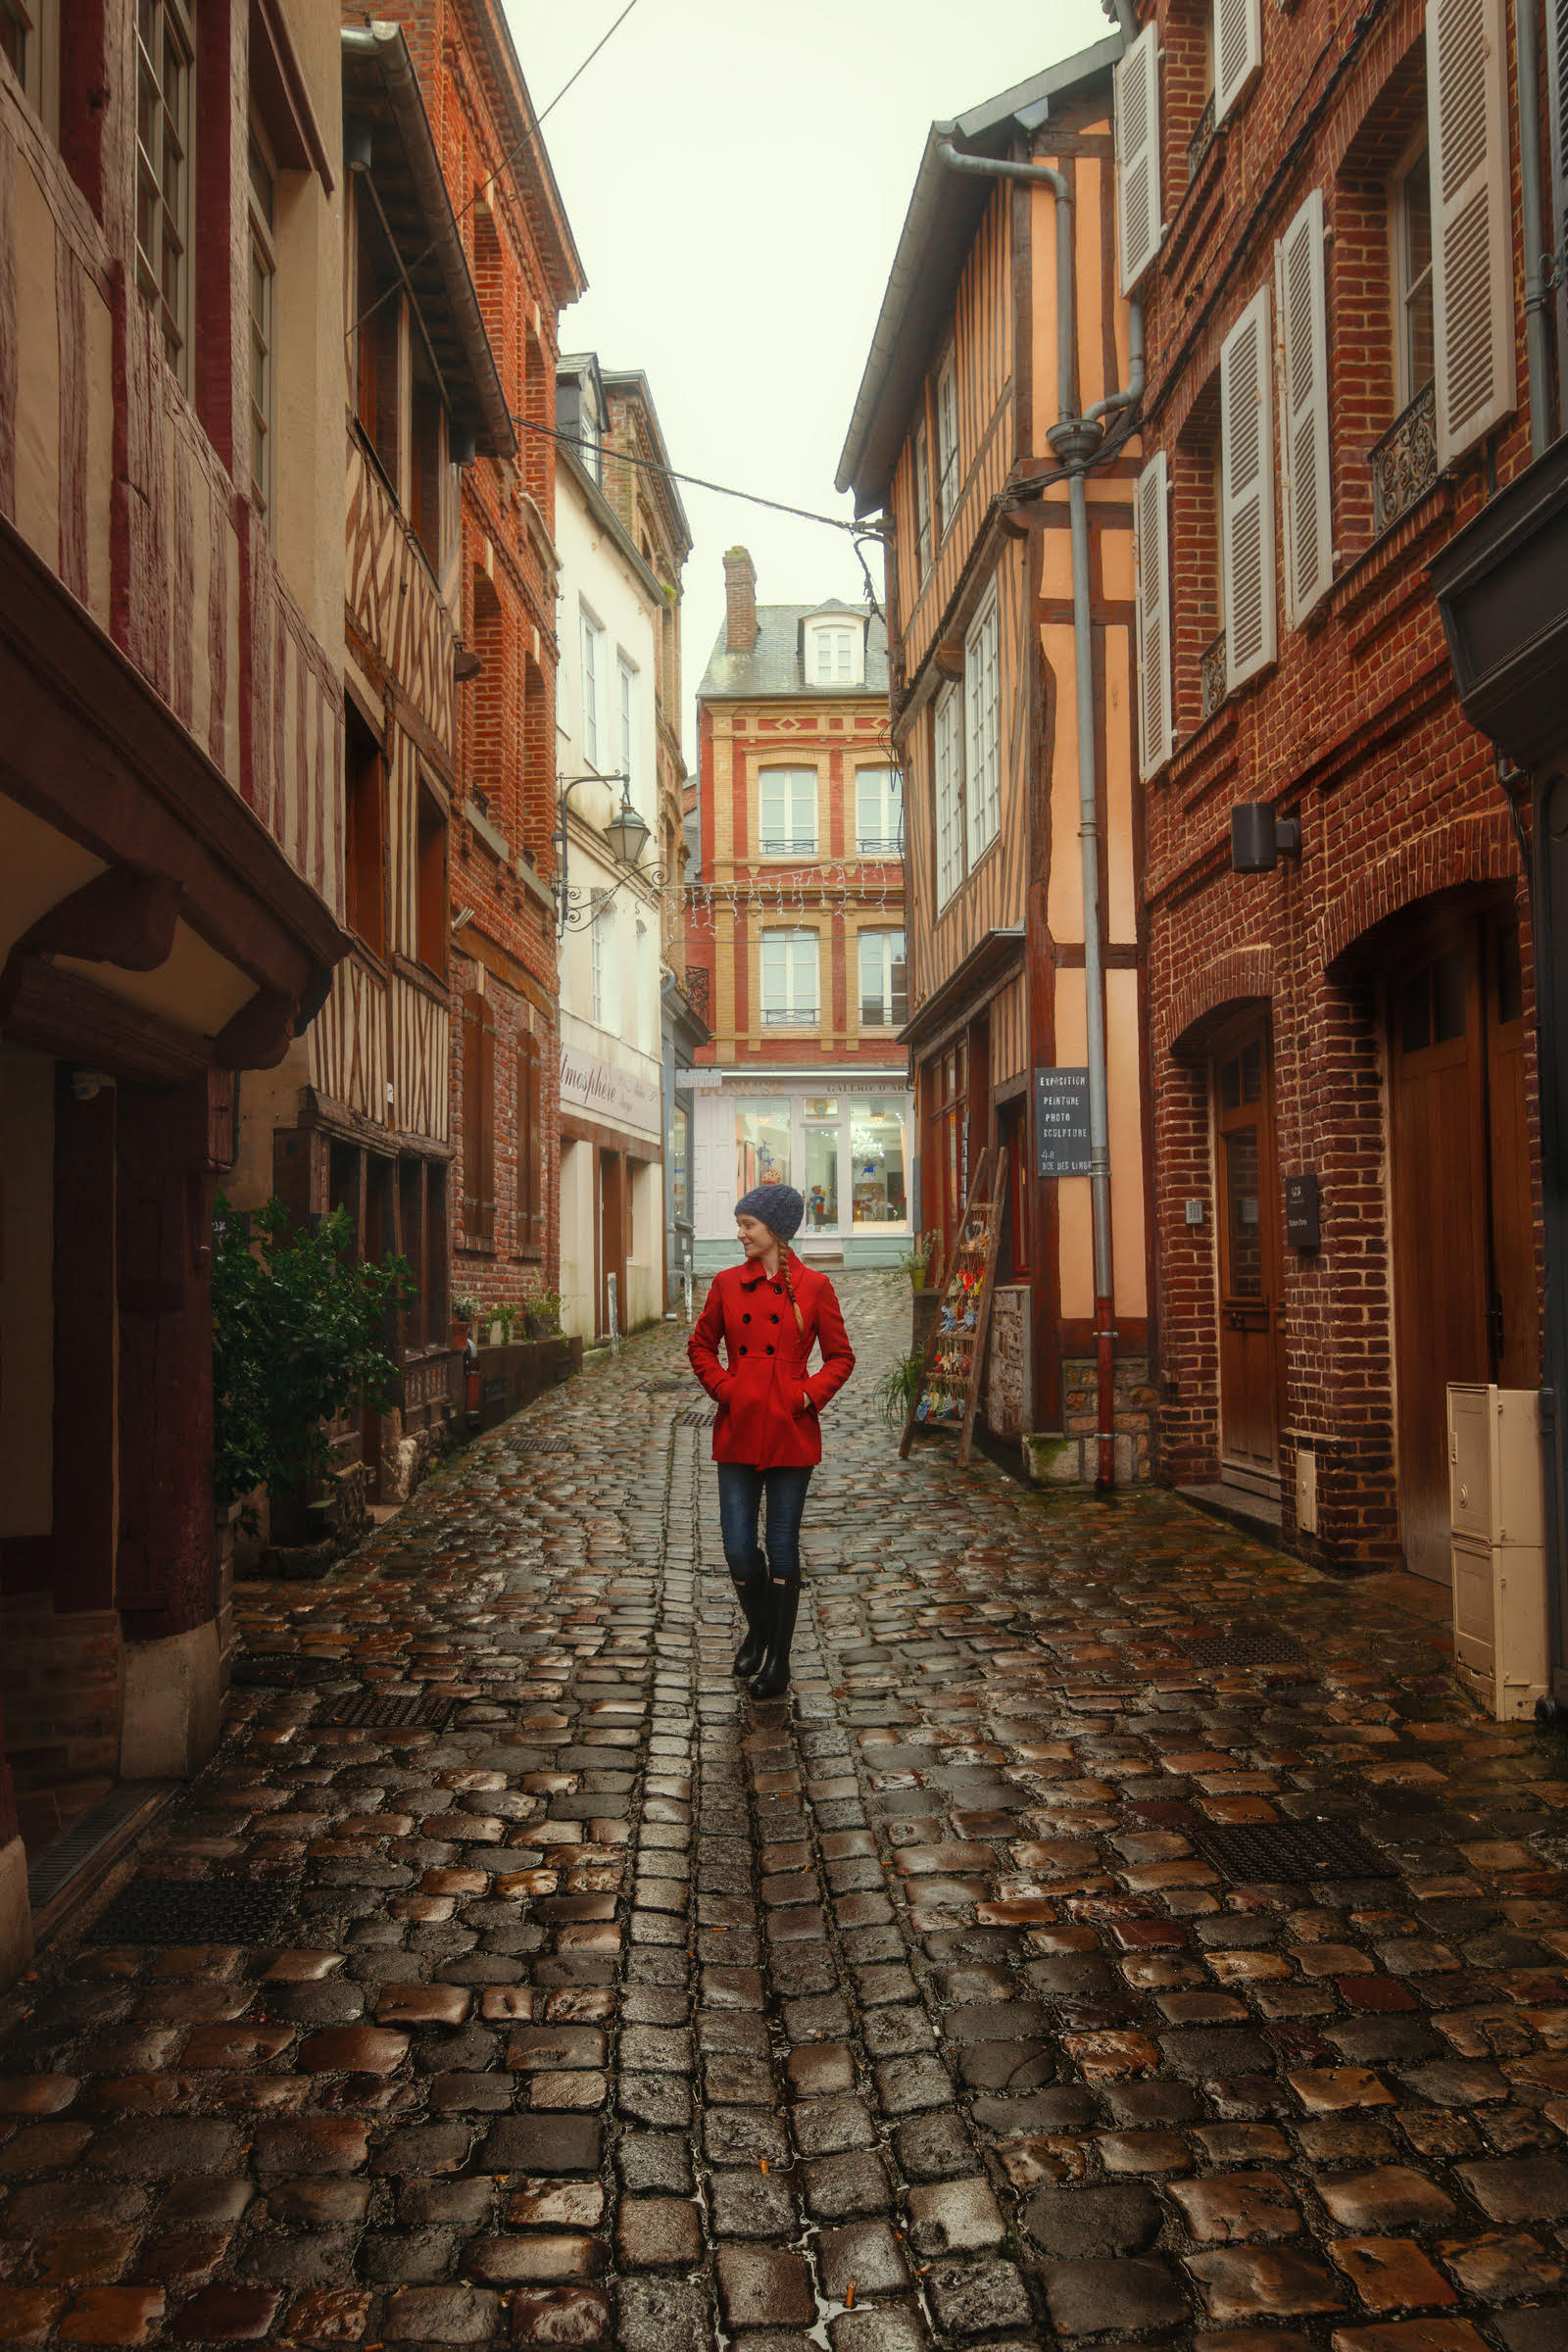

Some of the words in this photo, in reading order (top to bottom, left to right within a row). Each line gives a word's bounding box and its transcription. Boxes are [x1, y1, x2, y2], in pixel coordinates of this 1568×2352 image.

[1040, 1076, 1086, 1087] EXPOSITION
[1044, 1097, 1080, 1105] PEINTURE
[1045, 1112, 1071, 1122] PHOTO
[1043, 1128, 1088, 1138] SCULPTURE
[1056, 1160, 1069, 1170] DES
